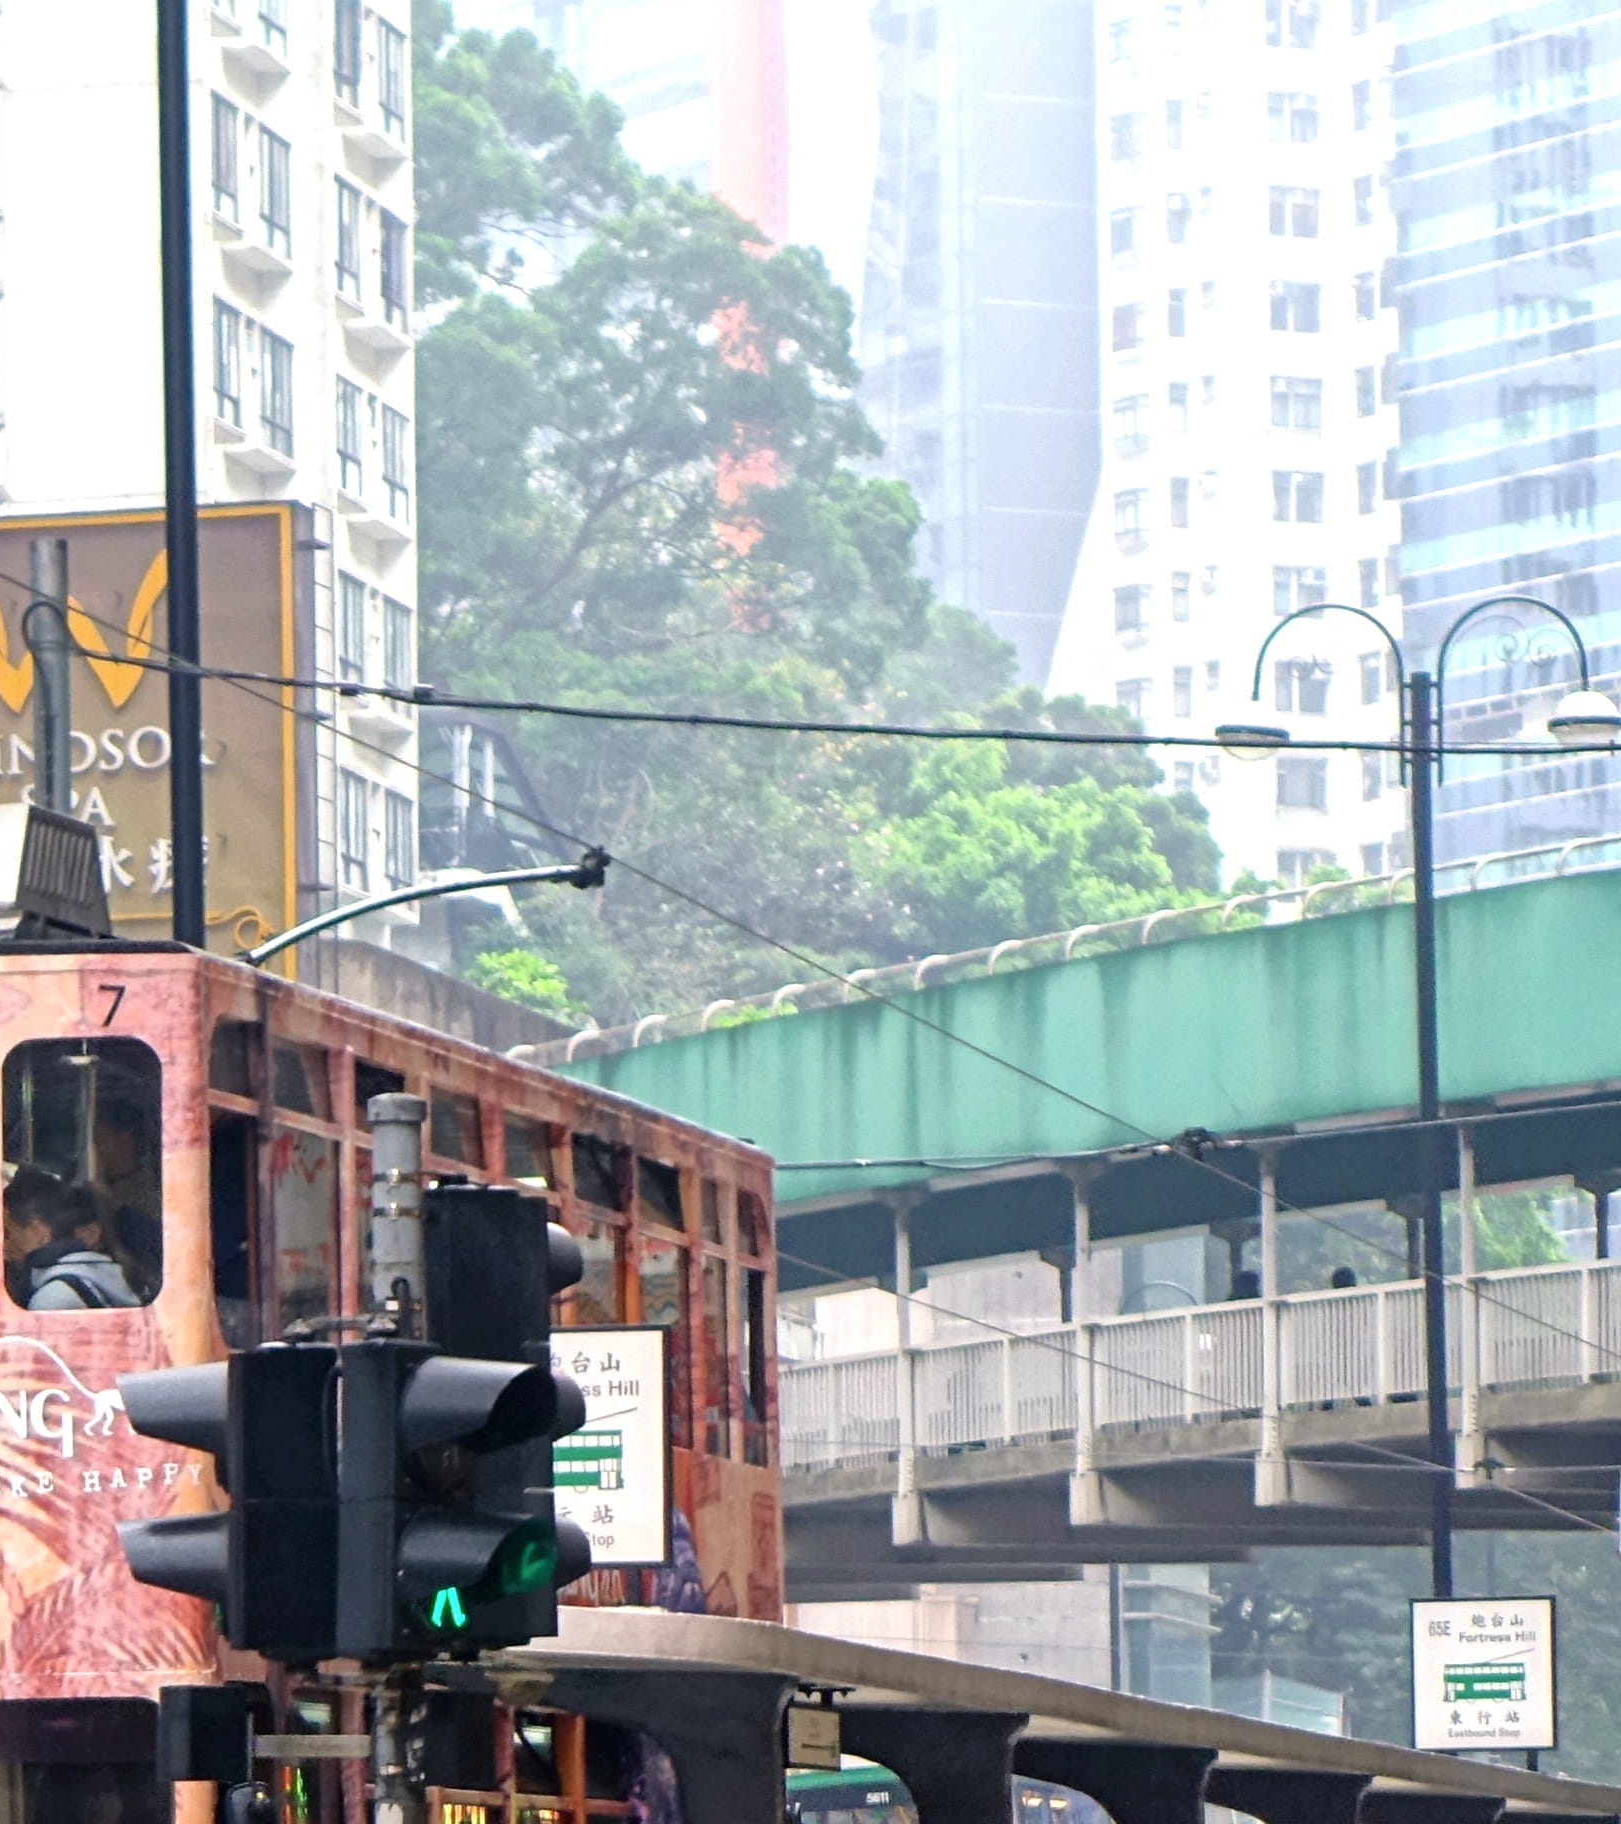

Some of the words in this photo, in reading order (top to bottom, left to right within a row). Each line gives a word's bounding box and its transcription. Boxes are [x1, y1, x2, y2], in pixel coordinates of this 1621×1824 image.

[98, 985, 126, 1027] 7
[608, 1380, 640, 1397] Hill
[83, 1462, 203, 1493] HAPPY
[1428, 1620, 1452, 1637] 65E
[1459, 1631, 1512, 1643] Fortress
[1515, 1631, 1536, 1643] Hill
[1450, 1710, 1520, 1725] 東行站
[1448, 1727, 1496, 1738] Eastbound
[1499, 1727, 1521, 1739] Stop
